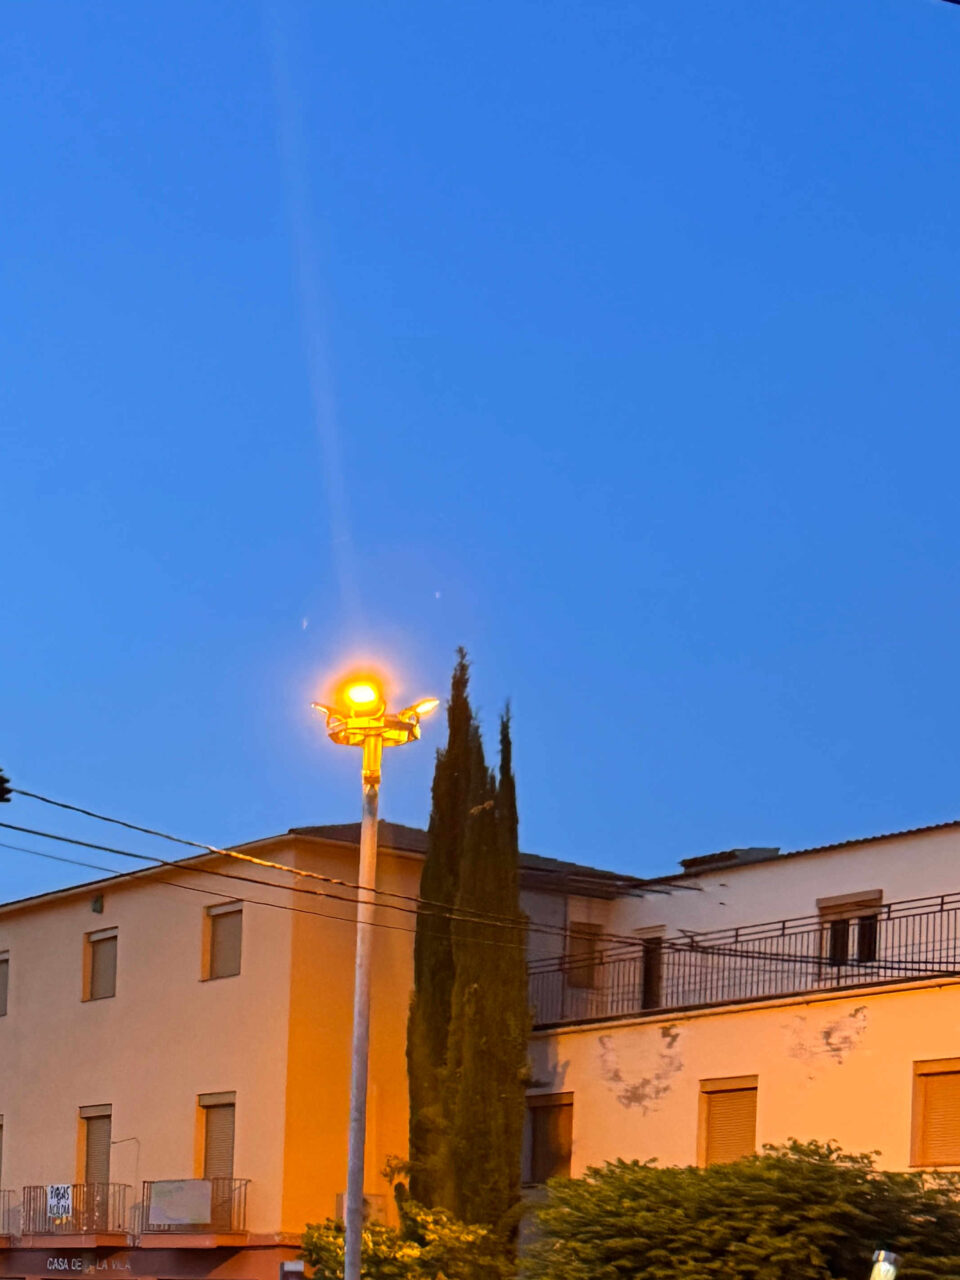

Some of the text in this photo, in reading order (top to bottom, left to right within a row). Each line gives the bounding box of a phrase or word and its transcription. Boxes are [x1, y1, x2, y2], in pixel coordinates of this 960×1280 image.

[47, 1257, 132, 1270] CASA DE LA VILA
